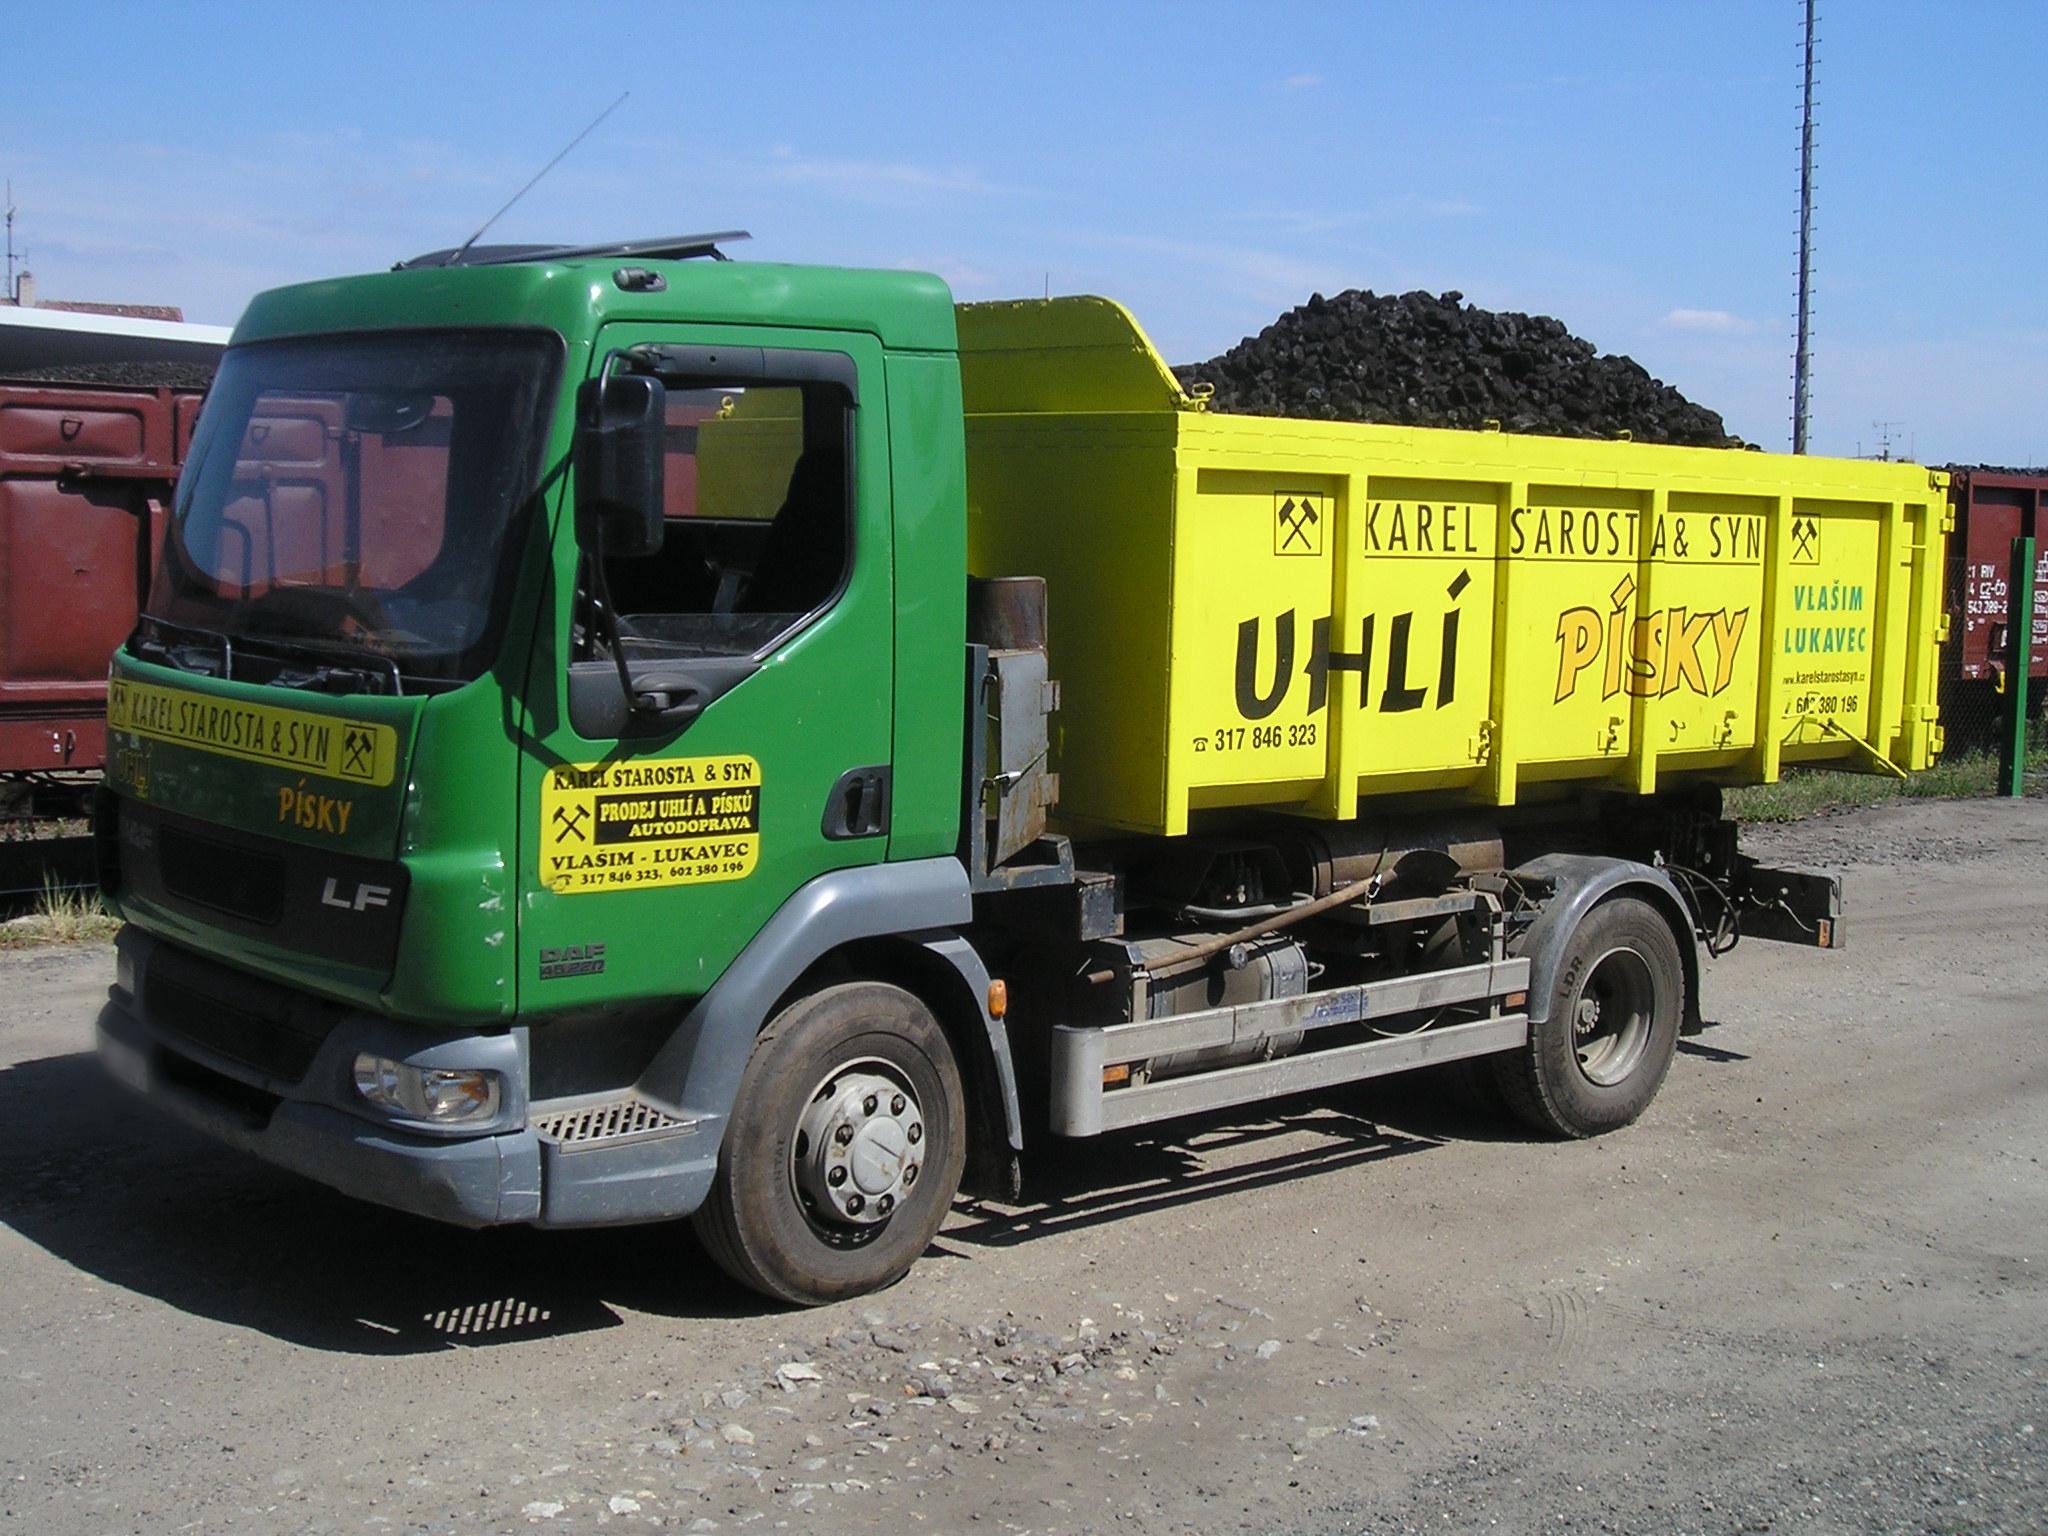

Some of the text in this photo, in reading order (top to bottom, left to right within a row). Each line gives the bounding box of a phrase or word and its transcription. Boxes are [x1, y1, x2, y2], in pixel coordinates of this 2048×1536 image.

[1365, 502, 1761, 559] KAREL SAROSTA & SYN
[1794, 579, 1863, 611] VLAŠIM
[1235, 568, 1472, 720] UHLÍ
[1554, 573, 1750, 705] PÍSKY
[1784, 627, 1866, 653] LUKAVEC
[1818, 696, 1838, 714] 380
[1841, 695, 1858, 713] 196
[131, 692, 330, 764] KAREL STAROSTA & SYN
[1215, 724, 1317, 751] 317 846 323
[553, 762, 753, 791] KAREL STAROSTA & SYN
[278, 778, 352, 835] PÍSKY
[600, 789, 752, 822] PRODEJ UHLÍ A PÍSKŮ
[628, 816, 751, 837] AUTODOPRAVA
[551, 849, 634, 870] VLAŠIM
[653, 842, 749, 863] LUKAVEC
[581, 873, 605, 885] 317
[609, 871, 633, 883] 846
[670, 865, 693, 877] 602
[696, 863, 718, 876] 380
[723, 861, 744, 873] 196
[321, 876, 391, 911] LF
[540, 943, 605, 963] DAF
[1560, 956, 1582, 999] LDR
